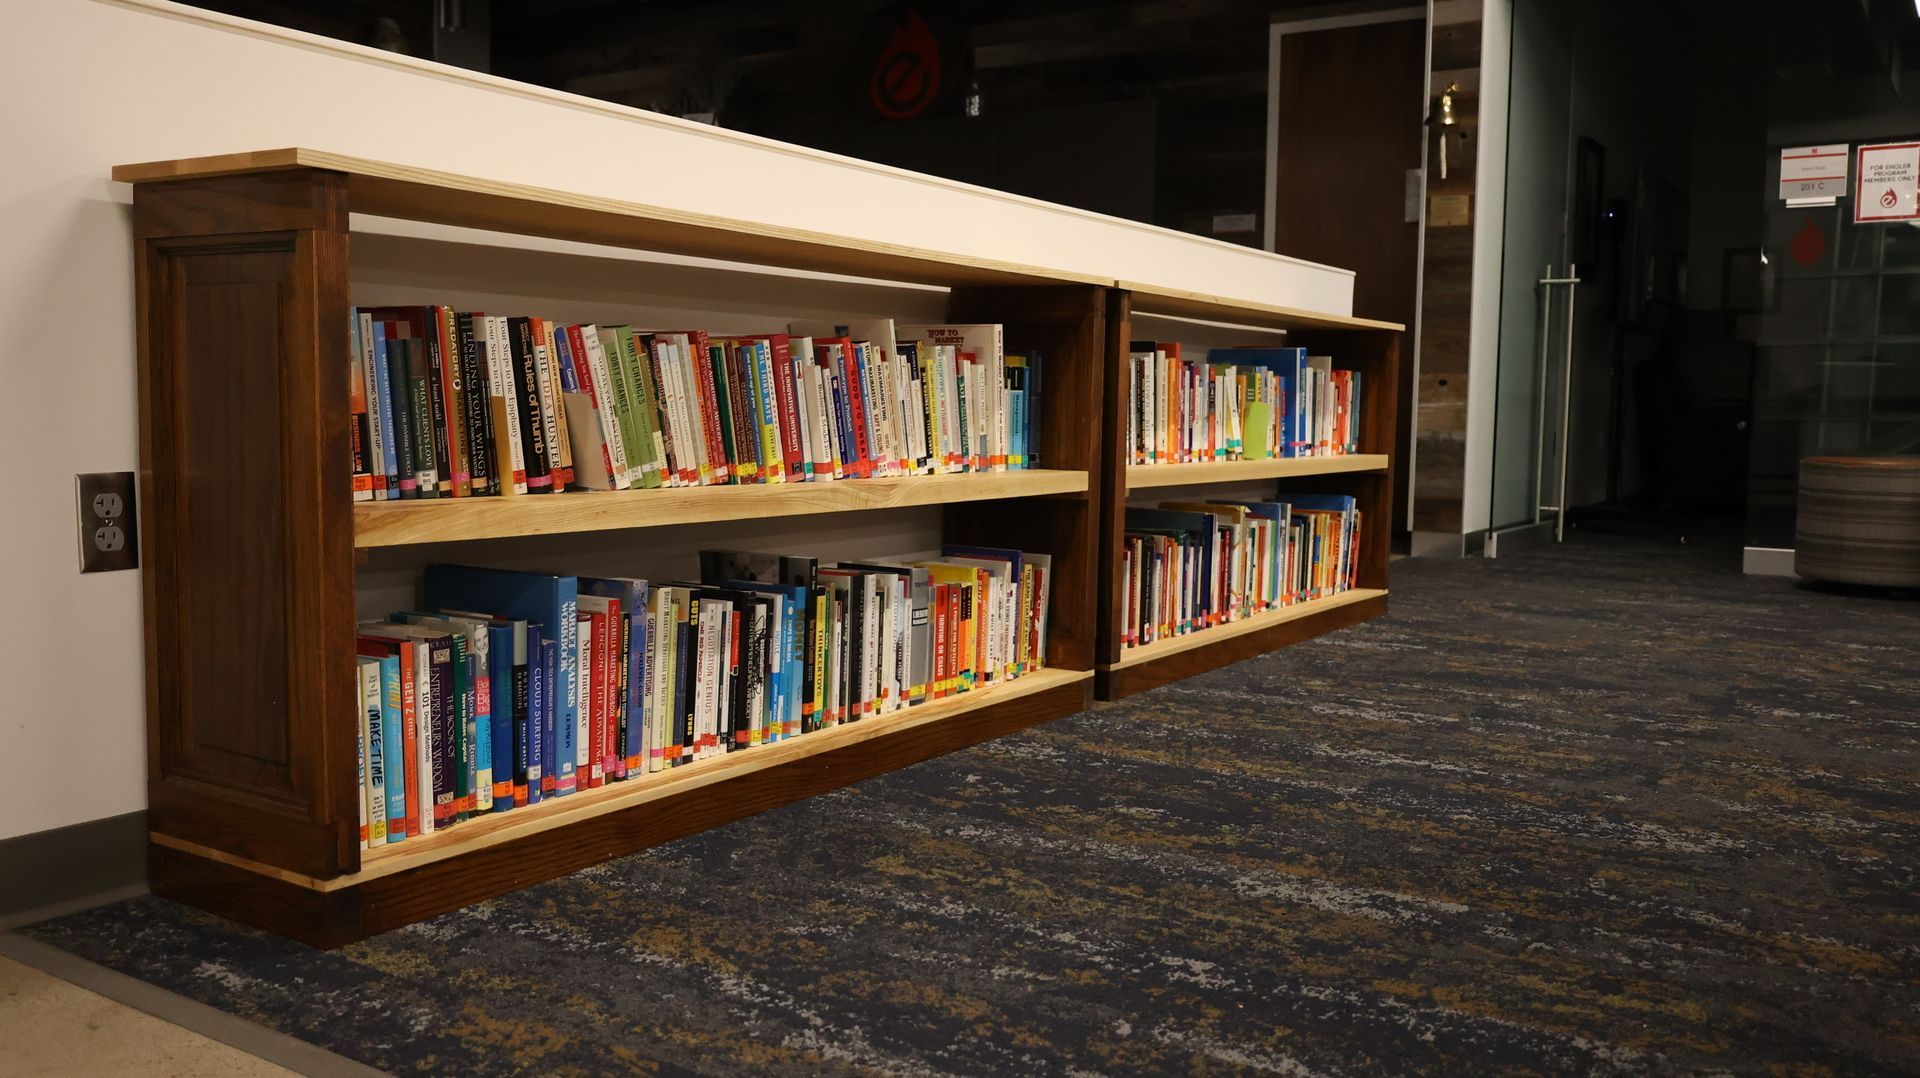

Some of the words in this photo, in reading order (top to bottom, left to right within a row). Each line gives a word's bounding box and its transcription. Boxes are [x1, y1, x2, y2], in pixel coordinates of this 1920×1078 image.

[487, 320, 495, 341] Four
[500, 320, 508, 340] Four
[467, 332, 479, 389] FINDING
[489, 344, 498, 368] Steps
[502, 344, 510, 368] Steps
[523, 354, 535, 390] Rules
[538, 348, 547, 375] THE
[548, 331, 556, 364] DEVELOPING
[553, 377, 562, 403] BUSINESS
[597, 357, 608, 387] SOCIAL
[626, 338, 637, 363] FORTY
[632, 367, 646, 405] CHANCES
[758, 350, 766, 365] THE
[449, 311, 460, 377] PREDATORY
[456, 392, 466, 454] MARKETING
[494, 371, 499, 379] to
[506, 370, 512, 378] to
[610, 352, 619, 375] FORTY
[616, 378, 628, 414] CHANCES
[760, 369, 769, 393] THIRD
[839, 360, 848, 394] Prototype
[368, 350, 376, 396] ENGINEERING
[373, 417, 381, 449] START-UP
[529, 394, 536, 406] of
[543, 379, 552, 411] IDEA
[709, 371, 718, 409] ADVERTISING
[714, 411, 722, 442] METHODS
[764, 398, 772, 420] WAVE
[844, 396, 849, 404] to
[877, 365, 887, 421] MAXIMARKETING
[422, 408, 430, 443] CLIENTS
[472, 393, 482, 428] YOUR
[508, 397, 519, 439] Epiphany
[785, 376, 793, 414] INNOVATIVE
[790, 416, 798, 452] UNIVERSITY
[845, 405, 853, 433] Product
[855, 405, 862, 419] TO
[352, 415, 360, 453] BUSINESS
[530, 407, 544, 454] Thumb
[547, 415, 560, 468] HUNTER
[820, 419, 828, 442] Model
[857, 425, 867, 459] GREAT
[876, 434, 885, 454] COLLINS
[355, 454, 363, 472] LAW
[475, 432, 485, 476] WINGS
[560, 603, 568, 673] WORKBOOK
[568, 601, 576, 649] MARKET
[610, 616, 618, 649] GUERRILLA
[646, 618, 654, 654] GUERRILLA
[582, 640, 590, 671] Moral
[609, 650, 617, 683] MARKETING
[706, 625, 715, 677] NEGOTIATION
[938, 645, 944, 654] ON
[405, 682, 414, 704] GEN
[534, 667, 542, 708] CLOUD
[567, 655, 575, 708] ANALYSIS
[645, 655, 653, 697] ADVERTISING
[446, 694, 454, 714] THE
[580, 674, 589, 729] Intelligence
[596, 685, 604, 705] THE
[608, 685, 616, 717] HANDBOOK
[368, 709, 381, 746] MAKE
[447, 715, 455, 742] BOOK
[534, 711, 542, 761] SURFING
[371, 750, 383, 786] TIME
[447, 745, 455, 759] OF
[433, 749, 443, 792] WISDOM
